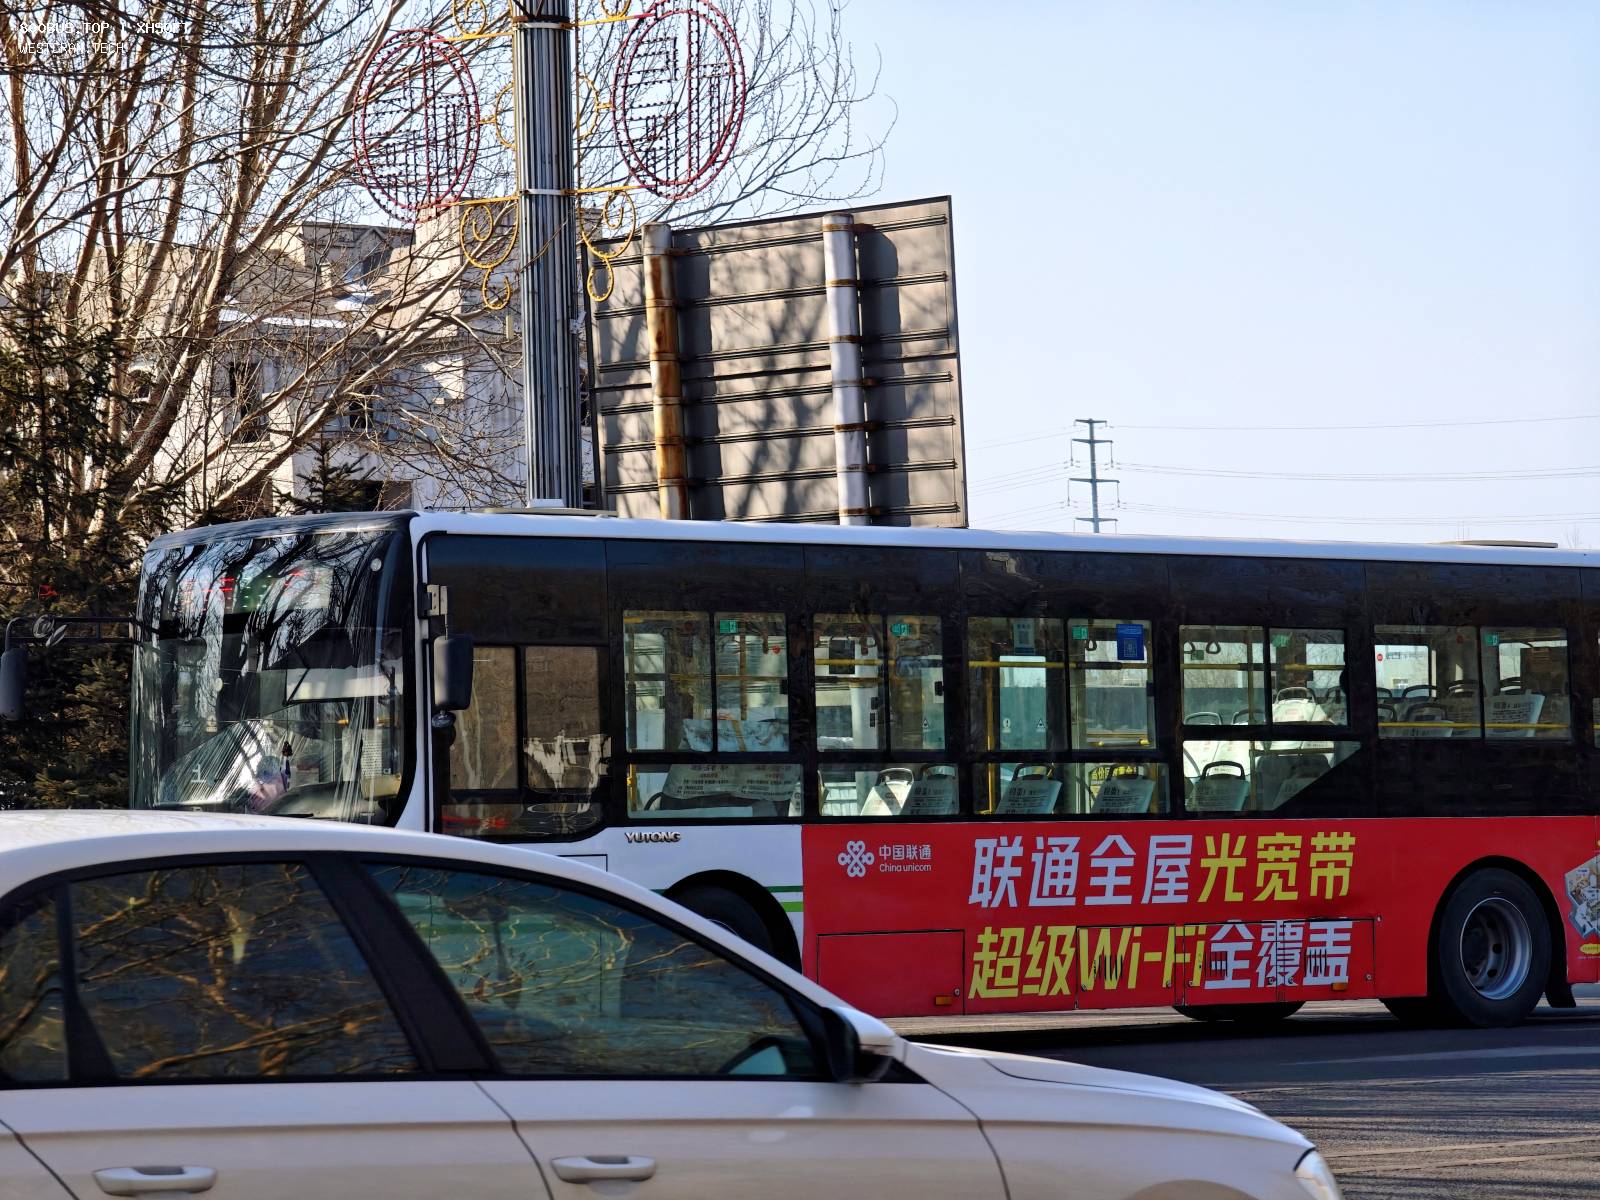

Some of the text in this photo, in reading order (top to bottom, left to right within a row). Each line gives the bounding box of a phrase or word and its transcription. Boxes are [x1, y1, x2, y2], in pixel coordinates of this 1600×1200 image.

[624, 831, 681, 843] YUTONG
[879, 844, 932, 860] 中国联通
[879, 863, 932, 872] China unicom
[968, 831, 1356, 908] 联通全屋光宽带
[967, 919, 1354, 1000] 超级Wi-Fi全覆盖
